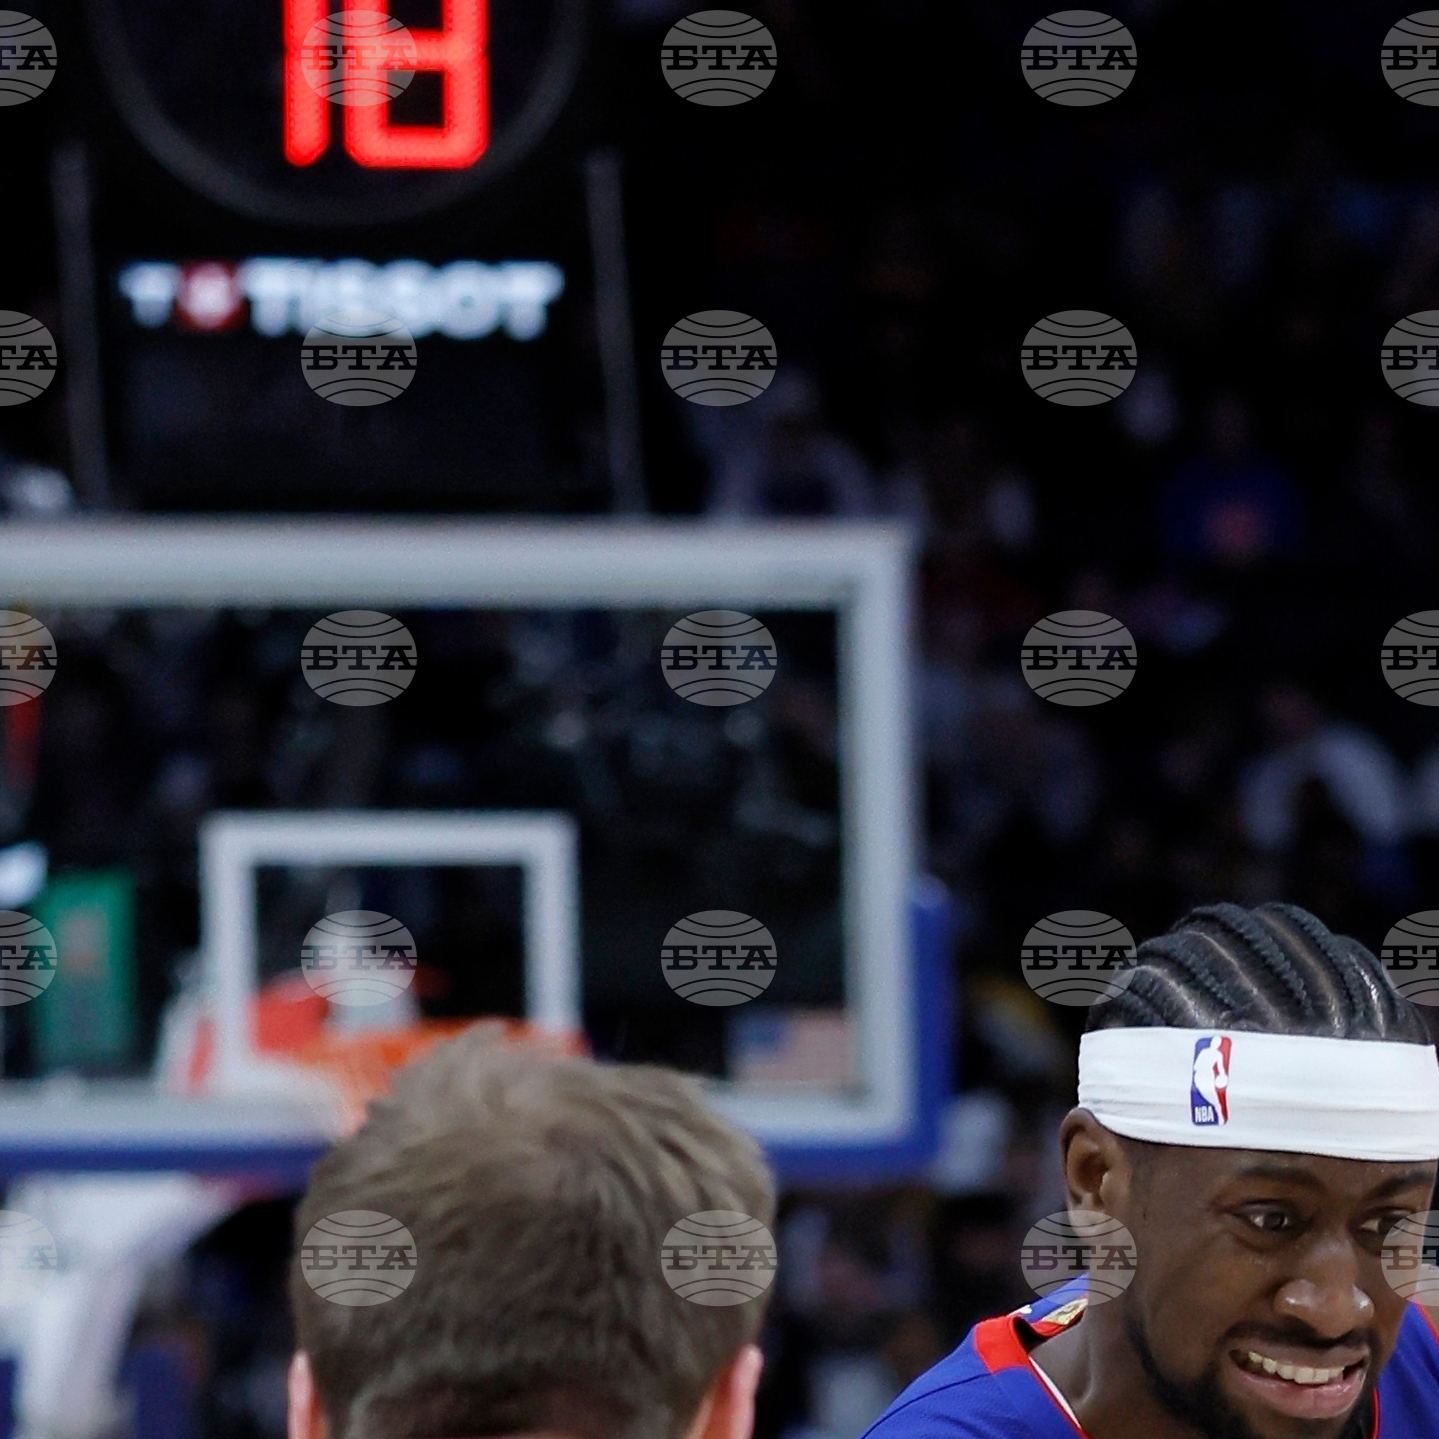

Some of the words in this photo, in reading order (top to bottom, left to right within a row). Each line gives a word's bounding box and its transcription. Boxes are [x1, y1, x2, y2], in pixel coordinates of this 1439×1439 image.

[283, 0, 489, 168] 18
[240, 257, 565, 339] TISSOT
[1194, 1105, 1215, 1123] NBA
